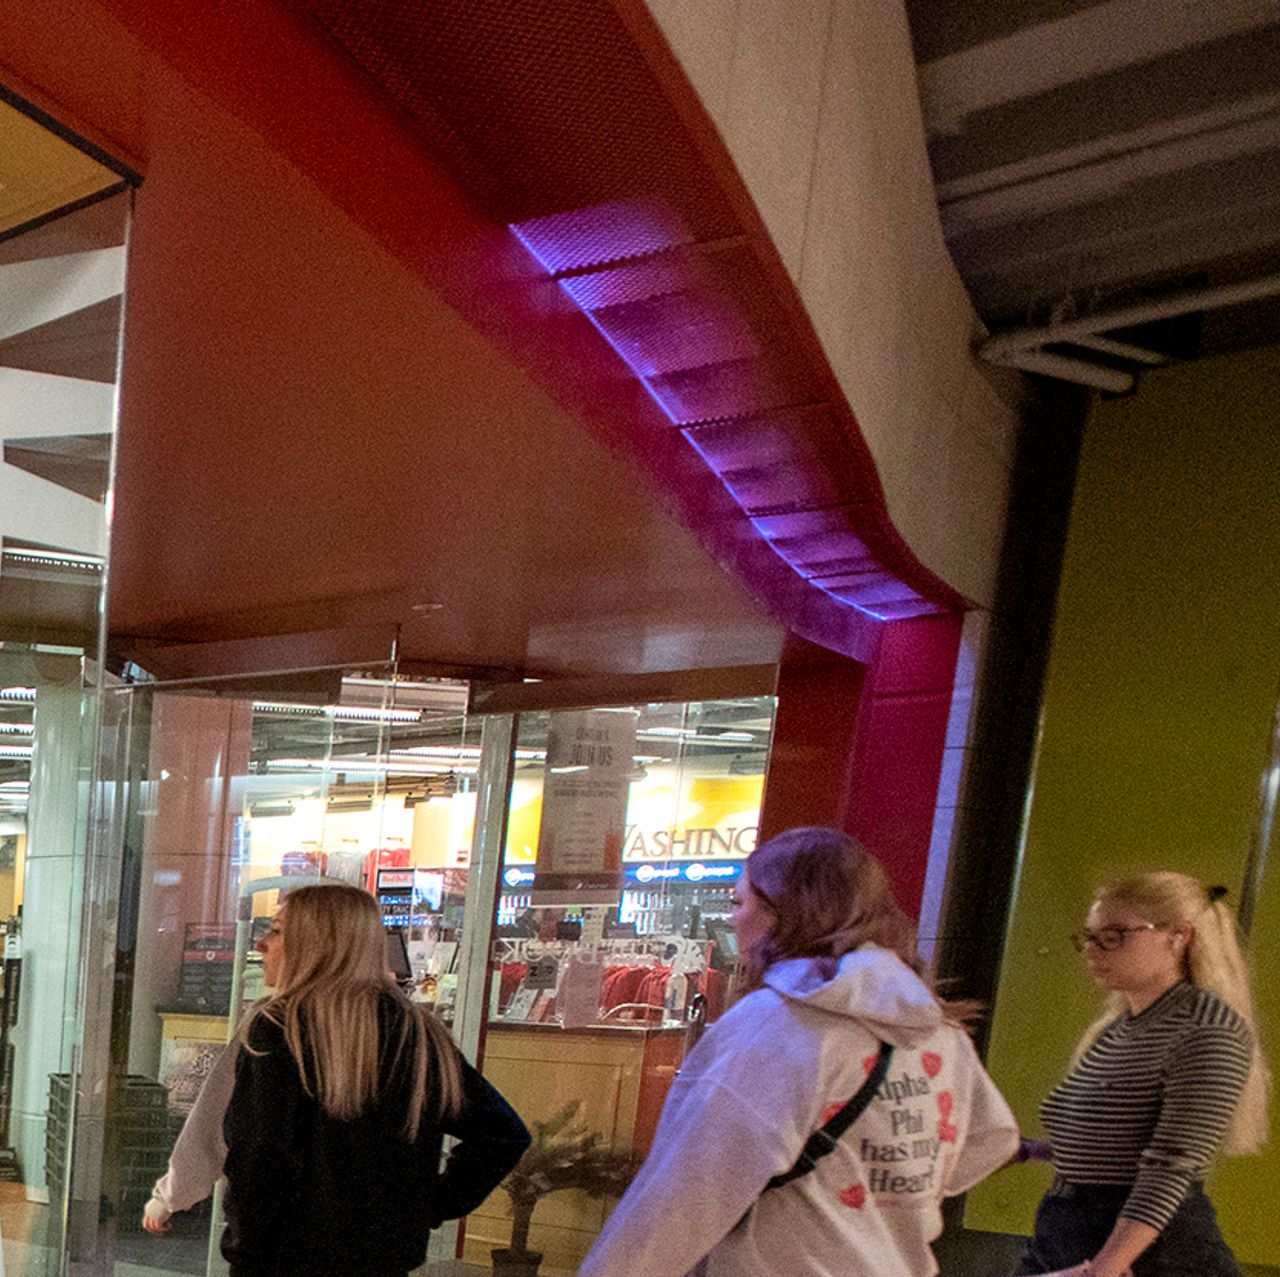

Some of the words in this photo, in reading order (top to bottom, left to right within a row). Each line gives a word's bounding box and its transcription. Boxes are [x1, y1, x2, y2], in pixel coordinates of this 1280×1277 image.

[625, 824, 760, 858] ASHING
[891, 1108, 923, 1136] Phi
[861, 1138, 909, 1163] has
[912, 1137, 940, 1162] my
